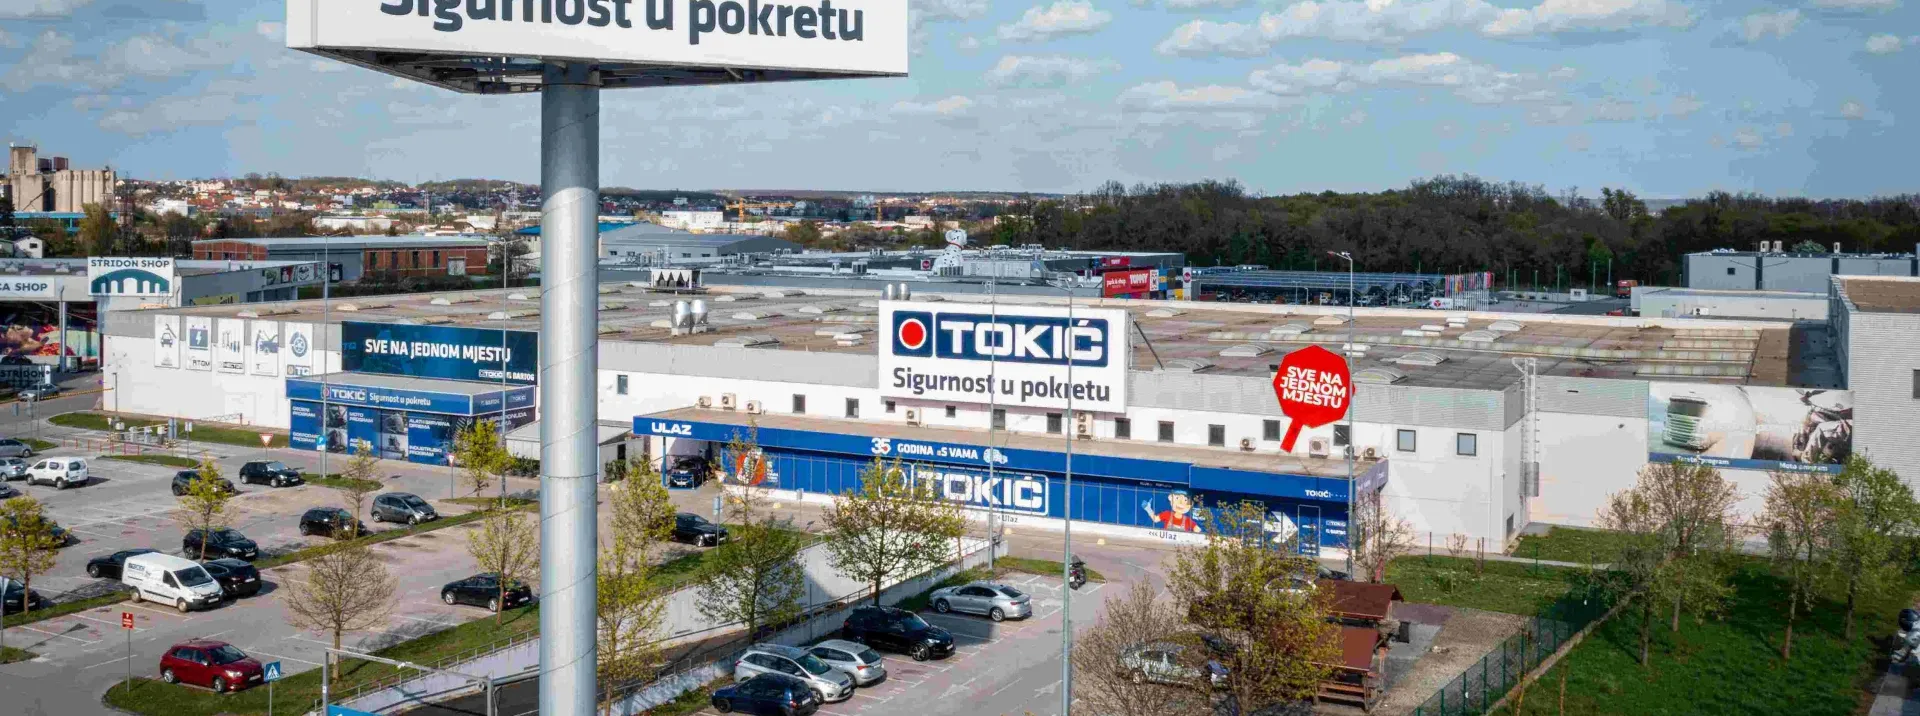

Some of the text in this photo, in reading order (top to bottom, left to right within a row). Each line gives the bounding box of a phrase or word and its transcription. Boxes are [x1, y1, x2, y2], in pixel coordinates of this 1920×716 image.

[646, 0, 673, 30] u
[689, 0, 863, 45] pokretu
[91, 259, 169, 268] STRIDON SHOP
[15, 283, 48, 291] SHOP
[941, 319, 1103, 361] TOKIĆ
[365, 339, 511, 363] SVE NA JEDNOM MJESTU
[893, 367, 1110, 402] Sigurnost u pokretu
[1287, 365, 1343, 386] SVE NA
[331, 389, 365, 401] TOKIĆ
[370, 393, 399, 404] Sigurnost
[405, 396, 431, 406] pokretu
[1280, 376, 1346, 398] JEDNOM
[1282, 388, 1342, 409] MJESTU
[651, 421, 692, 436] ULAZ
[871, 437, 891, 455] 35
[897, 443, 934, 456] GODINA
[949, 447, 979, 460] VAMA
[917, 470, 1043, 509] TOKIĆ
[1159, 531, 1177, 540] Ulaz
